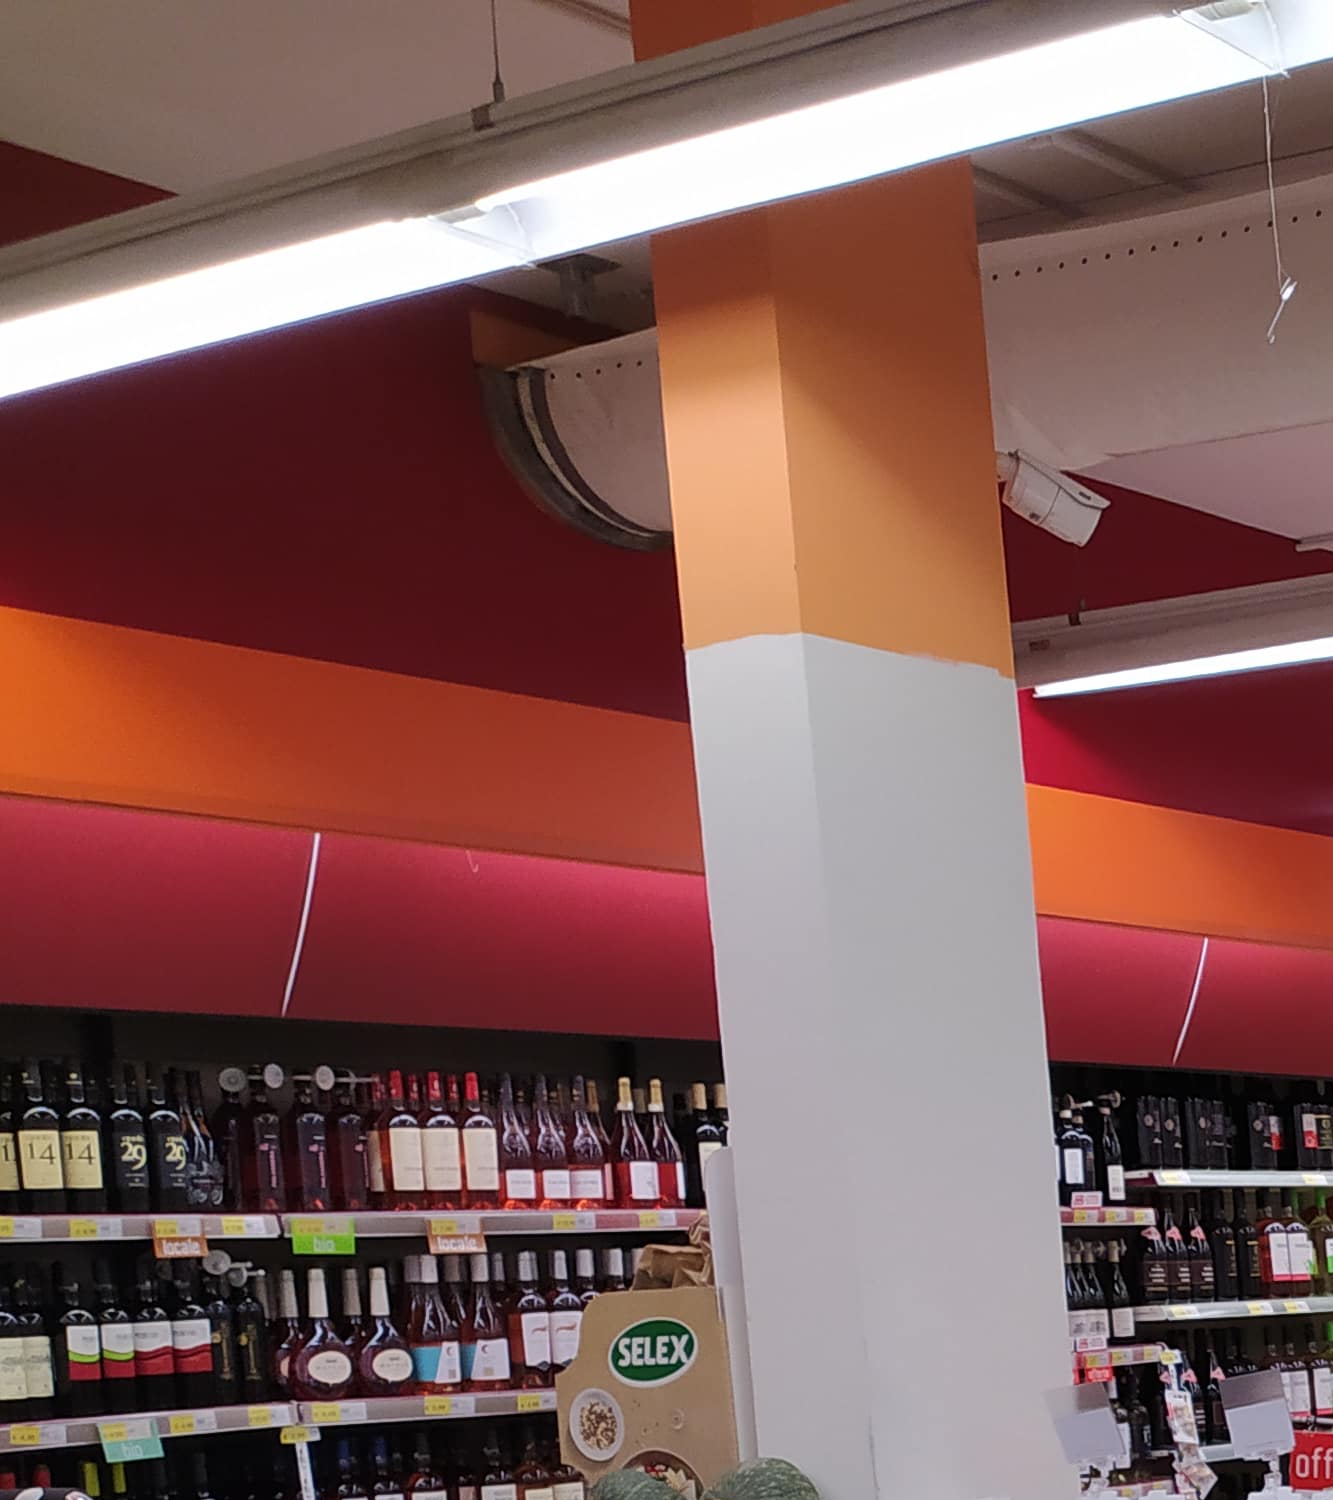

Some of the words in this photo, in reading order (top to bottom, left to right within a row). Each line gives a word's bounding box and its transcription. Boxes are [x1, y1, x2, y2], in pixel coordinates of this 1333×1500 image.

[28, 1142, 56, 1165] 14
[65, 1142, 96, 1165] 14
[120, 1141, 147, 1170] 29
[165, 1142, 187, 1170] 29
[618, 1334, 689, 1367] SELEX
